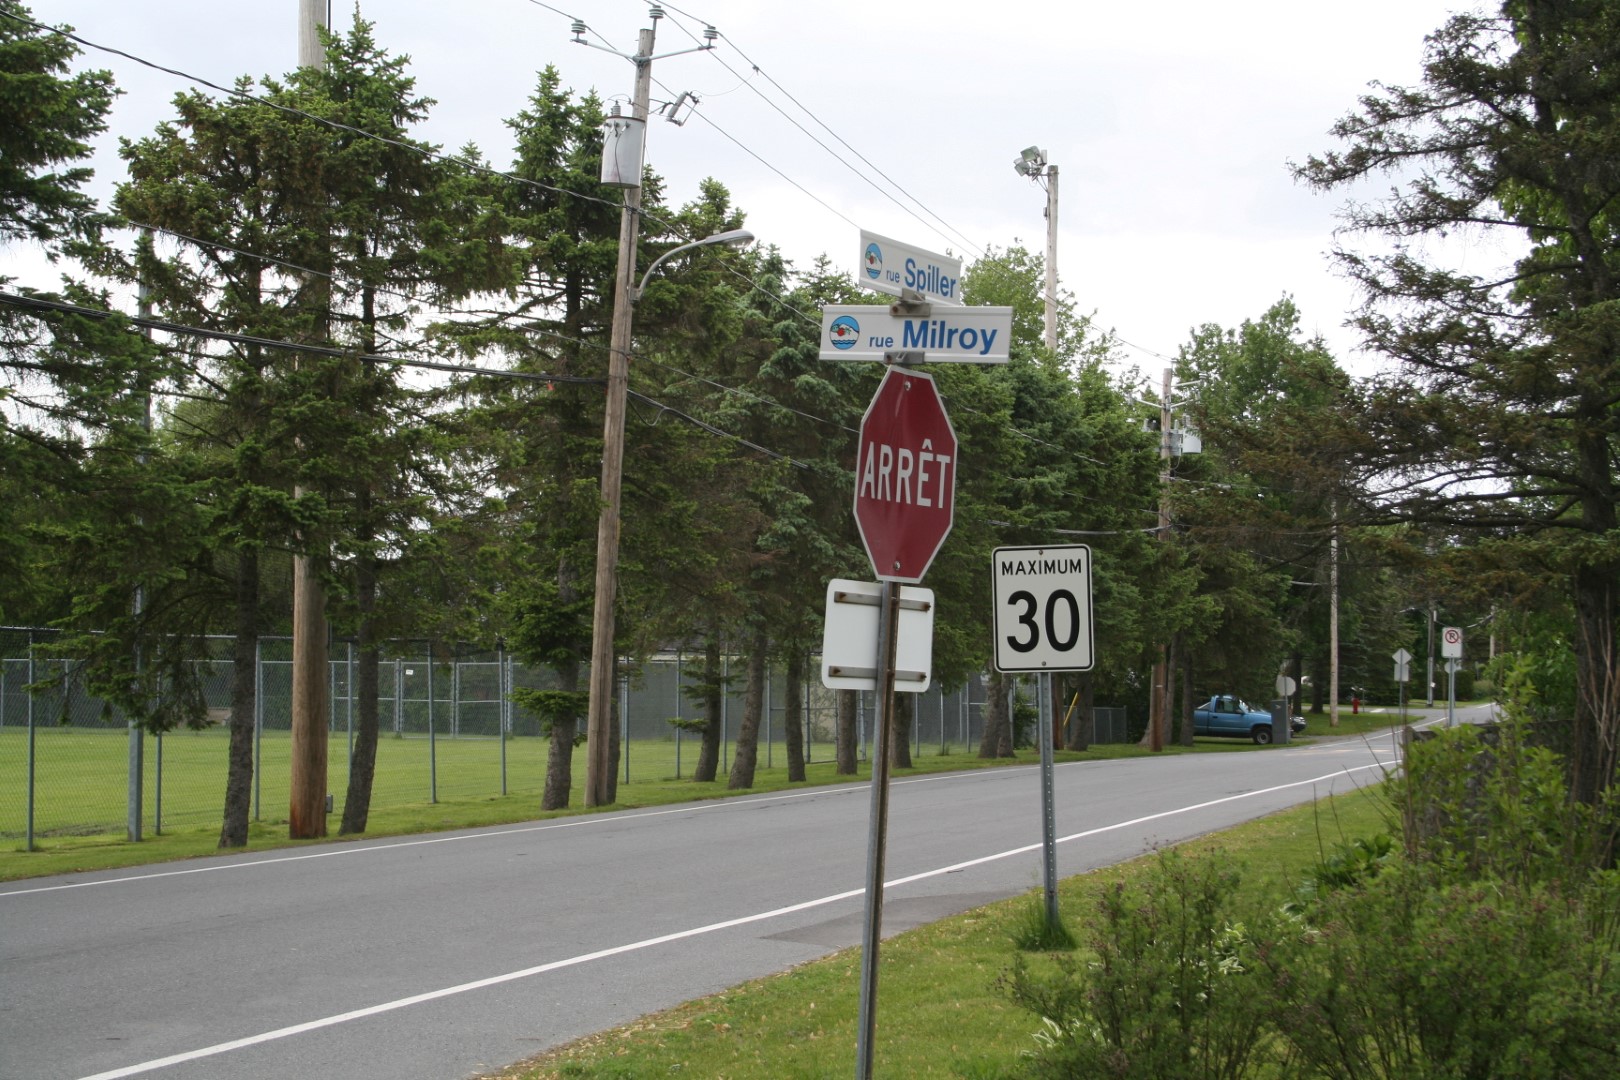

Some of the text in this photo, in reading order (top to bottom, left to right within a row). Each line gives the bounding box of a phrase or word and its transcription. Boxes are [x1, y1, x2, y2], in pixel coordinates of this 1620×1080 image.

[886, 258, 957, 298] rue Spiller
[869, 320, 998, 355] rue Milroy
[860, 438, 951, 509] ARRÊT
[1001, 558, 1082, 576] MAXIMUM
[1006, 589, 1080, 653] 30
